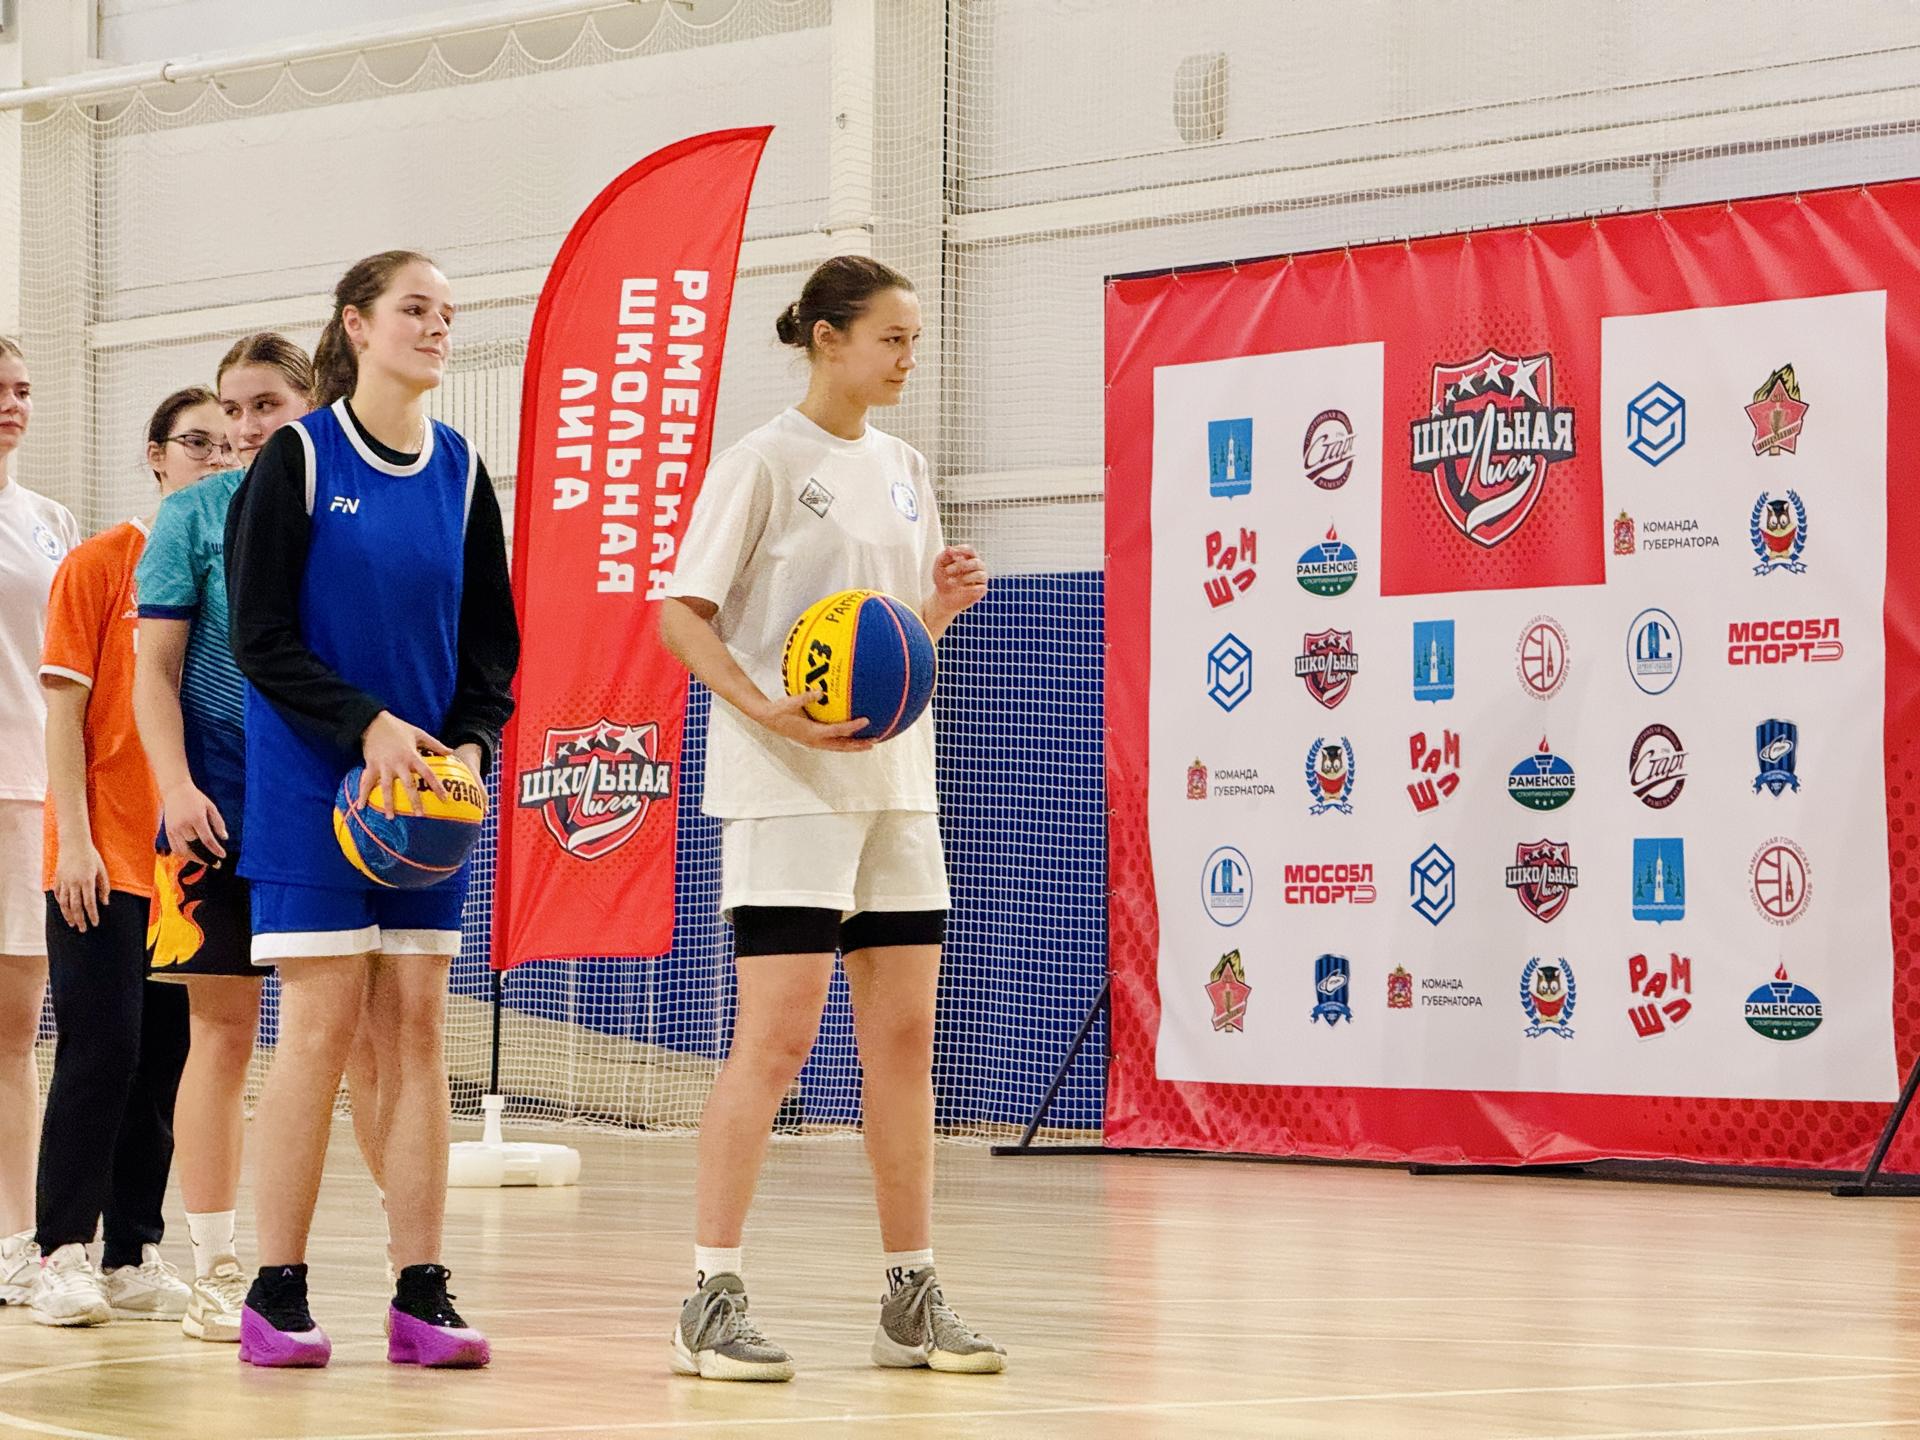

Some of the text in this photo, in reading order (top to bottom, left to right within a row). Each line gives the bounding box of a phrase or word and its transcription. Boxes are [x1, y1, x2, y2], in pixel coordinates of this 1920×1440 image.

[553, 368, 598, 510] ЛИГА
[597, 278, 658, 593] ШКОЛЬНАЯ
[646, 270, 709, 601] РАМЕНСКАЯ
[1413, 411, 1573, 465] ШКОЛЬНАЯ
[1460, 403, 1537, 497] Лига
[330, 496, 360, 514] FN
[1643, 519, 1699, 533] КОМАНДА
[1205, 527, 1256, 571] РАМ
[1643, 536, 1720, 550] ГУБЕРНАТОРА
[1296, 561, 1358, 575] РАМЕНСКОЕ
[1728, 618, 1840, 643] МОСОБЛ
[1728, 642, 1815, 665] СПОРТ
[1296, 654, 1358, 675] ШКОЛЬНАЯ
[1409, 729, 1460, 774] РАМ
[521, 763, 670, 804] ШКОЛЬНАЯ
[1214, 769, 1259, 780] КОМАНДА
[1508, 776, 1576, 787] РАМЕНСКОЕ
[567, 756, 642, 824] Лига
[1214, 785, 1276, 796] ГУБЕРНАТОРА
[1284, 863, 1374, 883] МОСОБЛ
[1507, 866, 1577, 885] ШКОЛЬНАЯ
[1284, 885, 1356, 904] СПОРТ
[1421, 978, 1463, 990] КОМАНДА
[1628, 953, 1692, 999] РАМ
[1421, 995, 1483, 1007] ГУБЕРНАТОРА
[1745, 1005, 1823, 1016] РАМЕНСКОЕ
